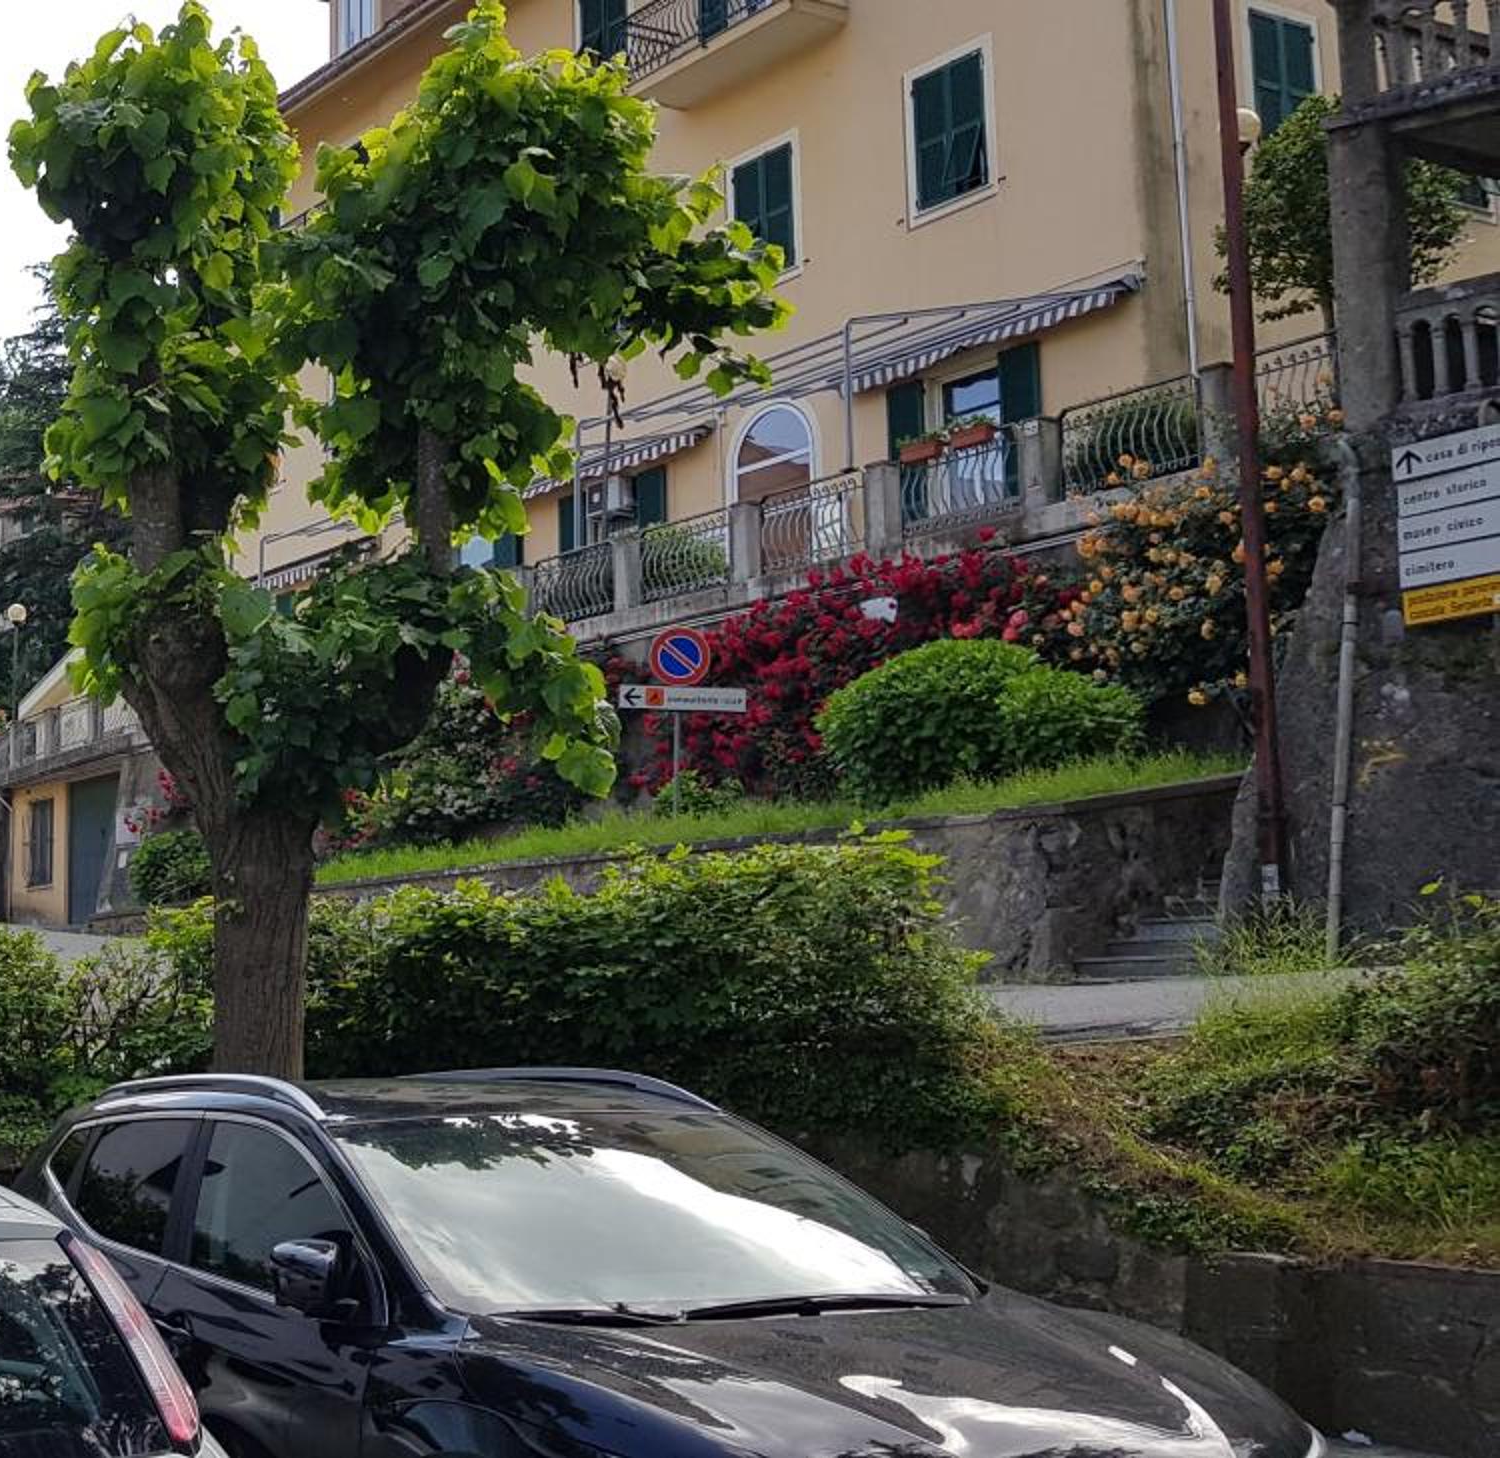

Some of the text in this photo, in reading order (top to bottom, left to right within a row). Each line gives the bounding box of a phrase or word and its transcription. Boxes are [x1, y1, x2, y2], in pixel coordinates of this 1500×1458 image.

[1425, 449, 1453, 463] casa
[1458, 442, 1468, 455] di
[1403, 479, 1487, 505] centro storico
[1403, 517, 1484, 540] museo civico
[1405, 560, 1455, 577] cimitero
